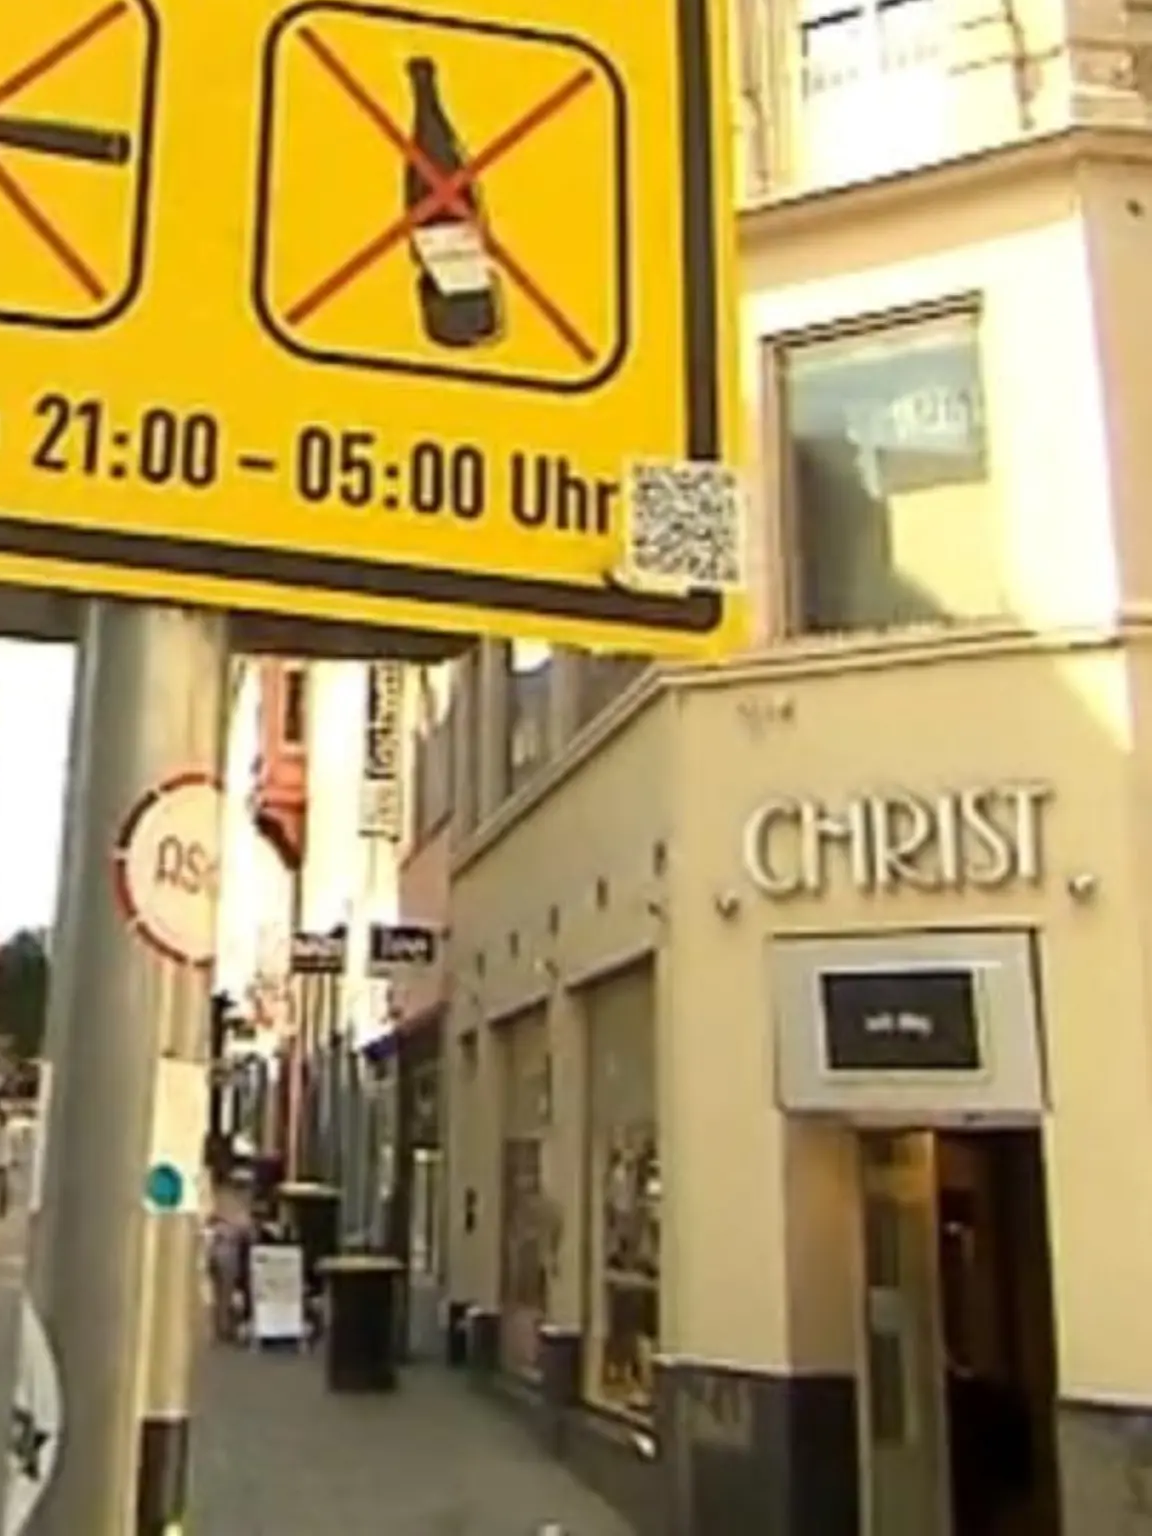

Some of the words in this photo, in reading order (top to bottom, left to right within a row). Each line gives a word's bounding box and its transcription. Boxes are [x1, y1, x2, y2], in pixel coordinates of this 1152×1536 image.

[33, 394, 218, 487] 21:00
[298, 426, 484, 520] 05:00
[511, 454, 620, 534] Uhr
[741, 780, 1057, 902] CHRIST
